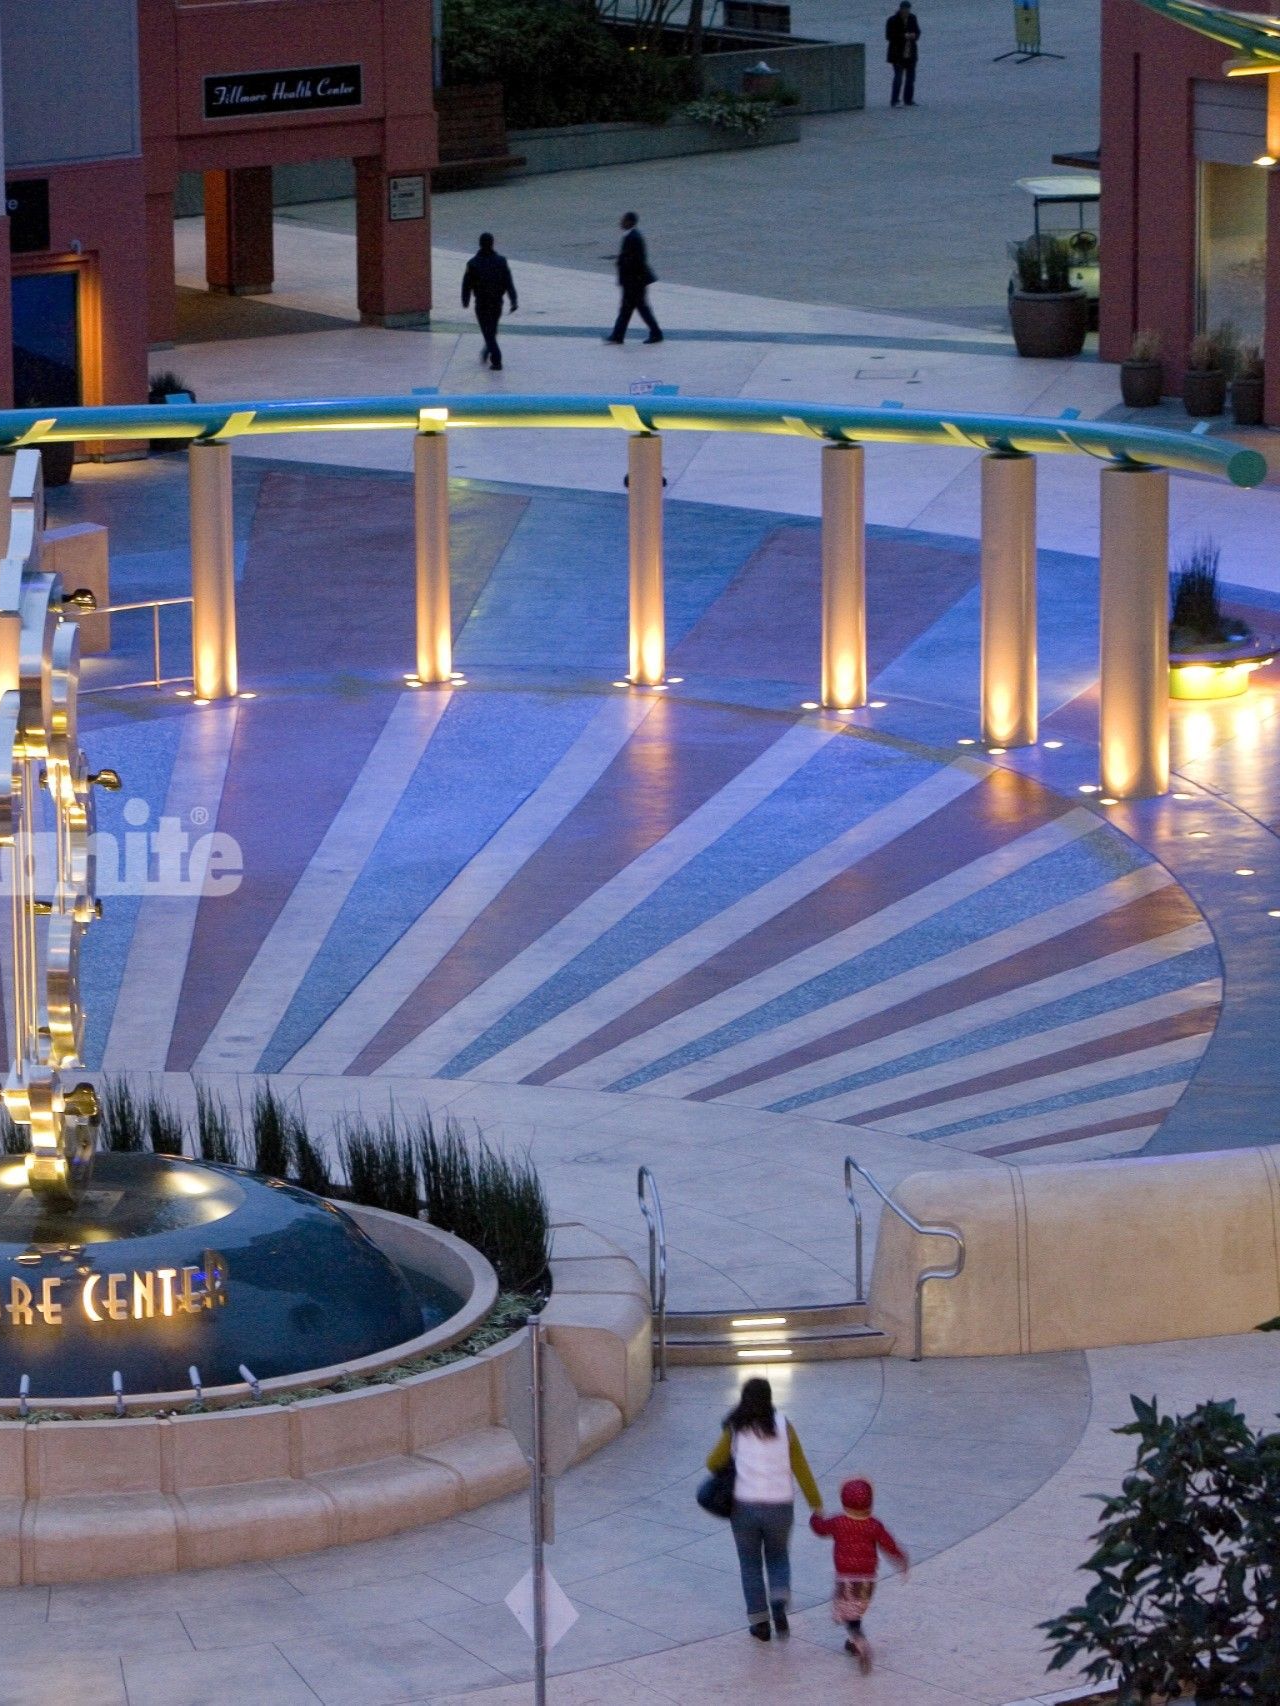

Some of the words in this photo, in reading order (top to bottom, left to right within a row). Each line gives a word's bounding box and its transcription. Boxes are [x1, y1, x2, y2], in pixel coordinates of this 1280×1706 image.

[212, 85, 268, 105] Fillmore
[272, 80, 312, 100] Health
[317, 78, 355, 96] Center
[82, 1248, 228, 1322] CENTER
